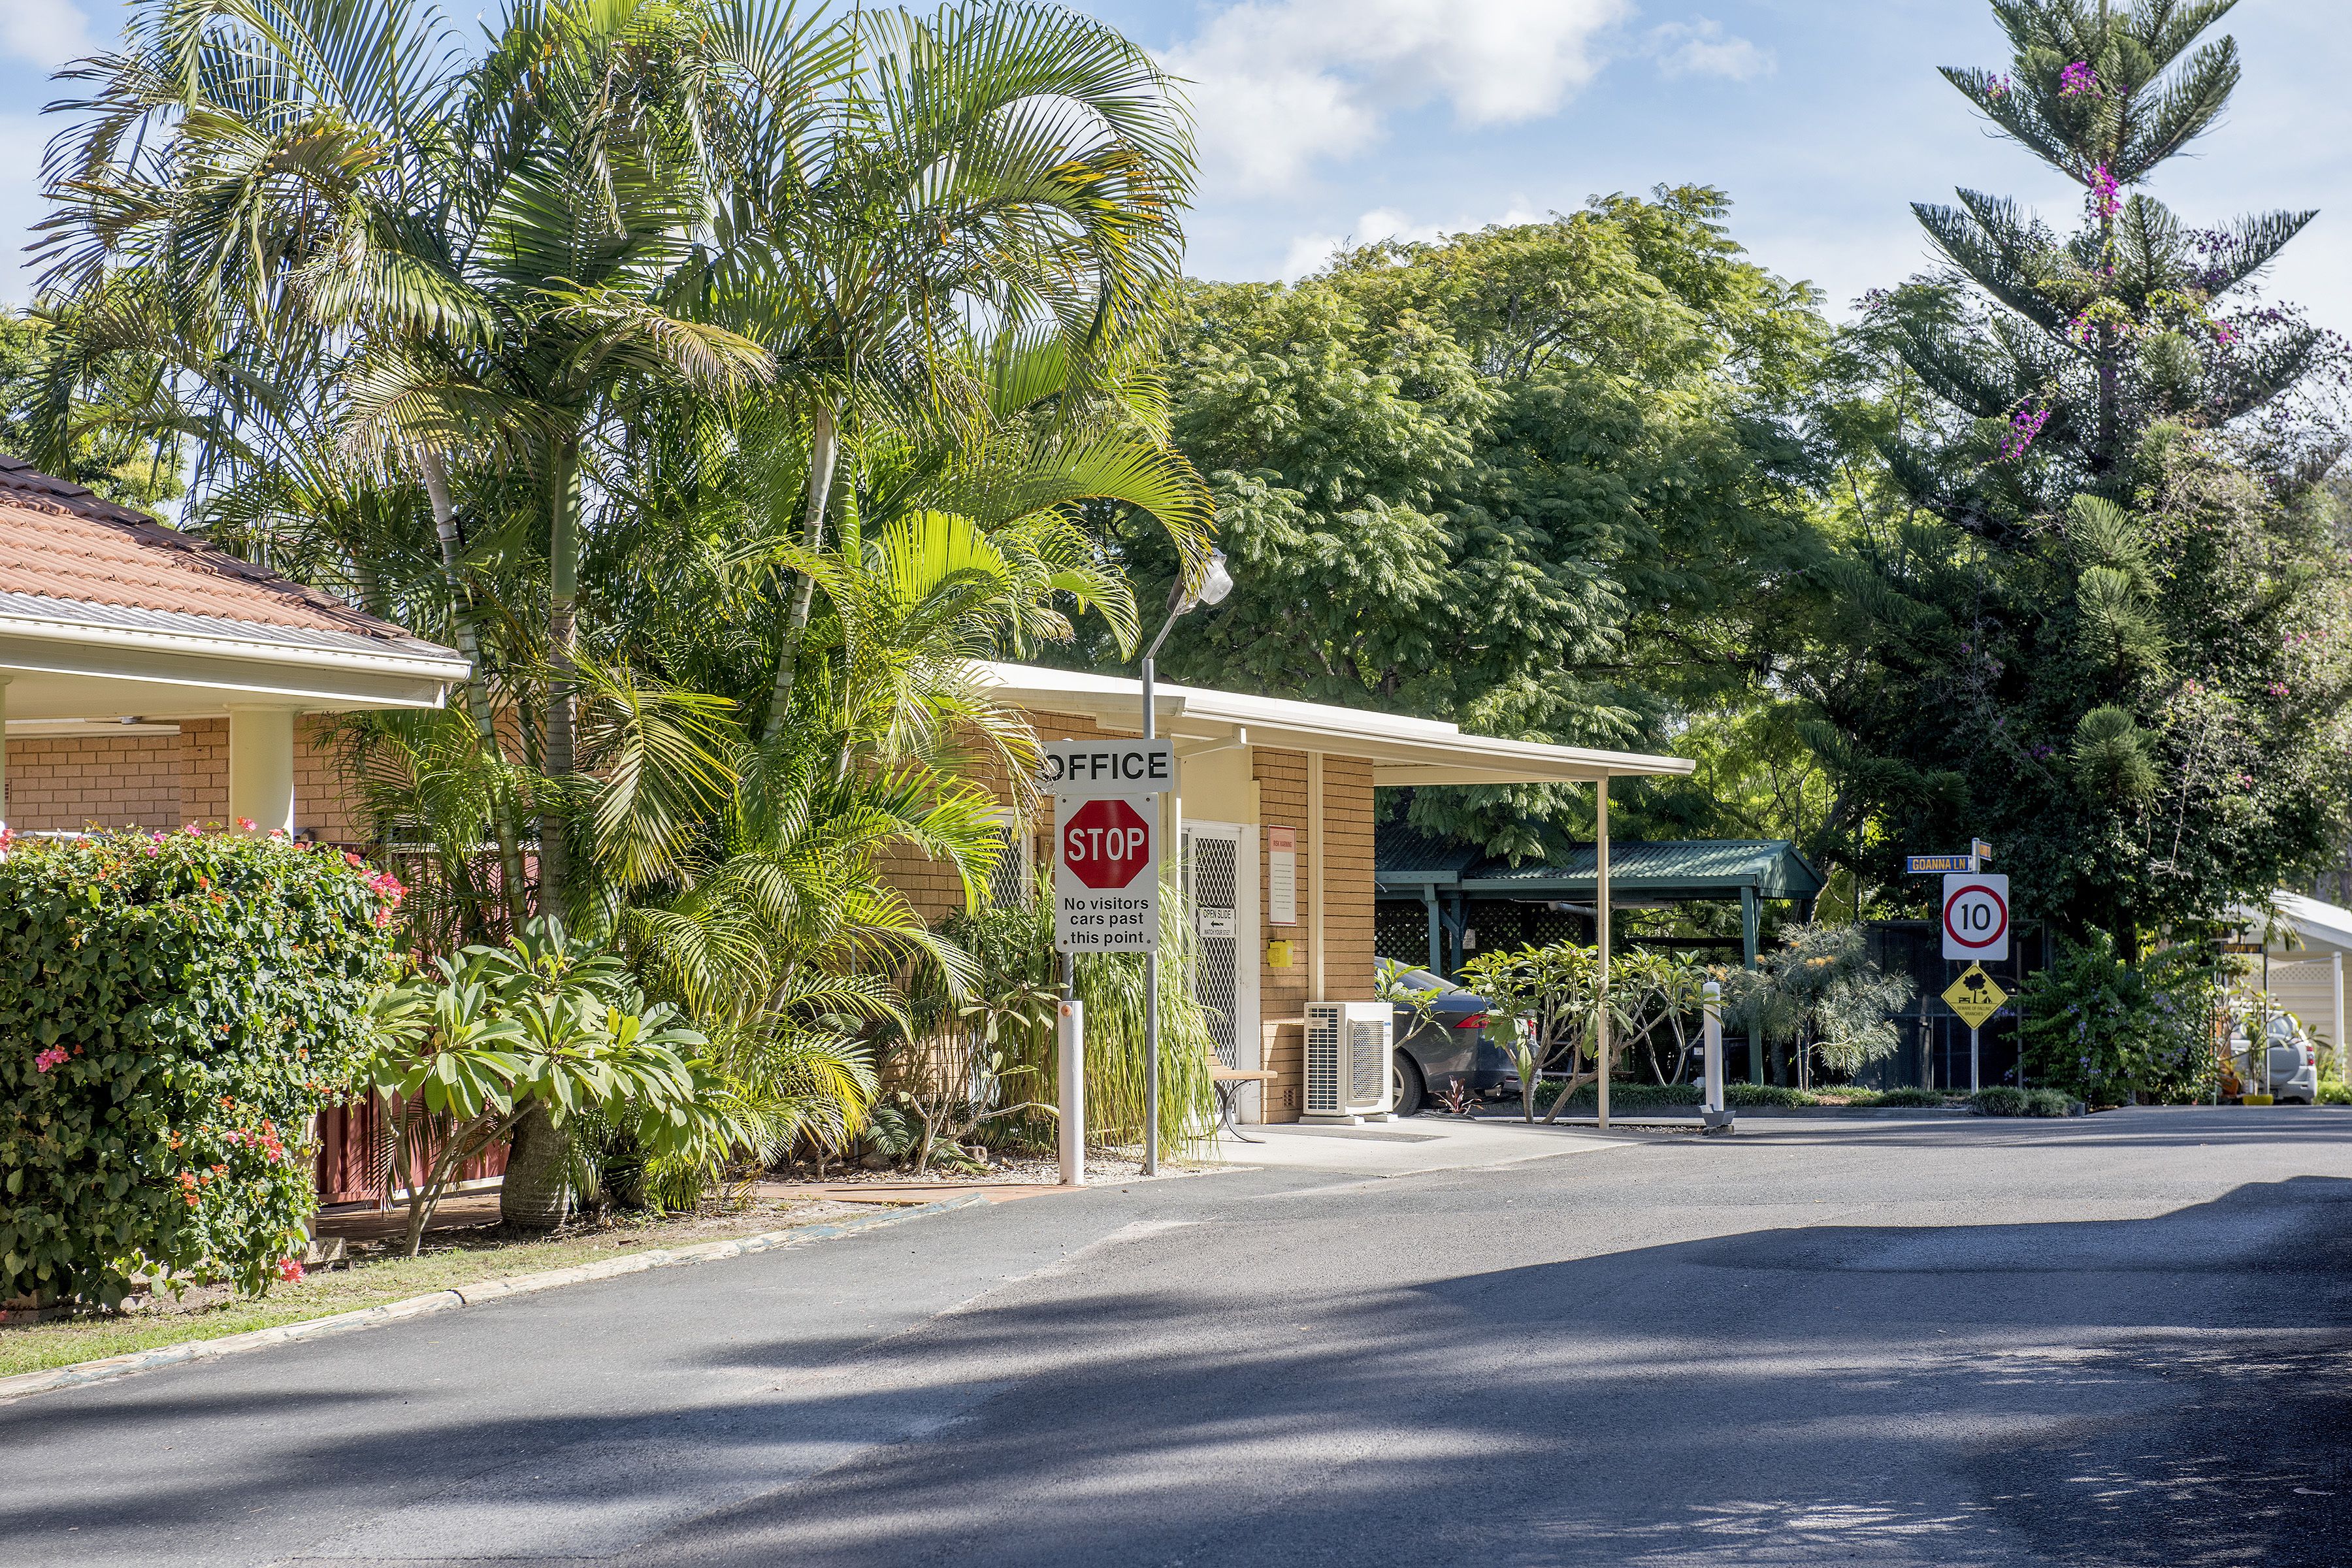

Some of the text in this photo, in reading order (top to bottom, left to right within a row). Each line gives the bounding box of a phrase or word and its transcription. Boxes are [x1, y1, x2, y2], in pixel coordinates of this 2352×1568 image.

[1041, 752, 1168, 781] OFFICE
[1068, 828, 1145, 861] STOP
[1912, 858, 1966, 870] GOANNA LN
[1064, 897, 1149, 910] No visitors
[1070, 912, 1144, 928] cars past
[1203, 909, 1231, 919] OPEN SLIDE
[1961, 904, 1991, 930] 10
[1070, 930, 1144, 947] this point
